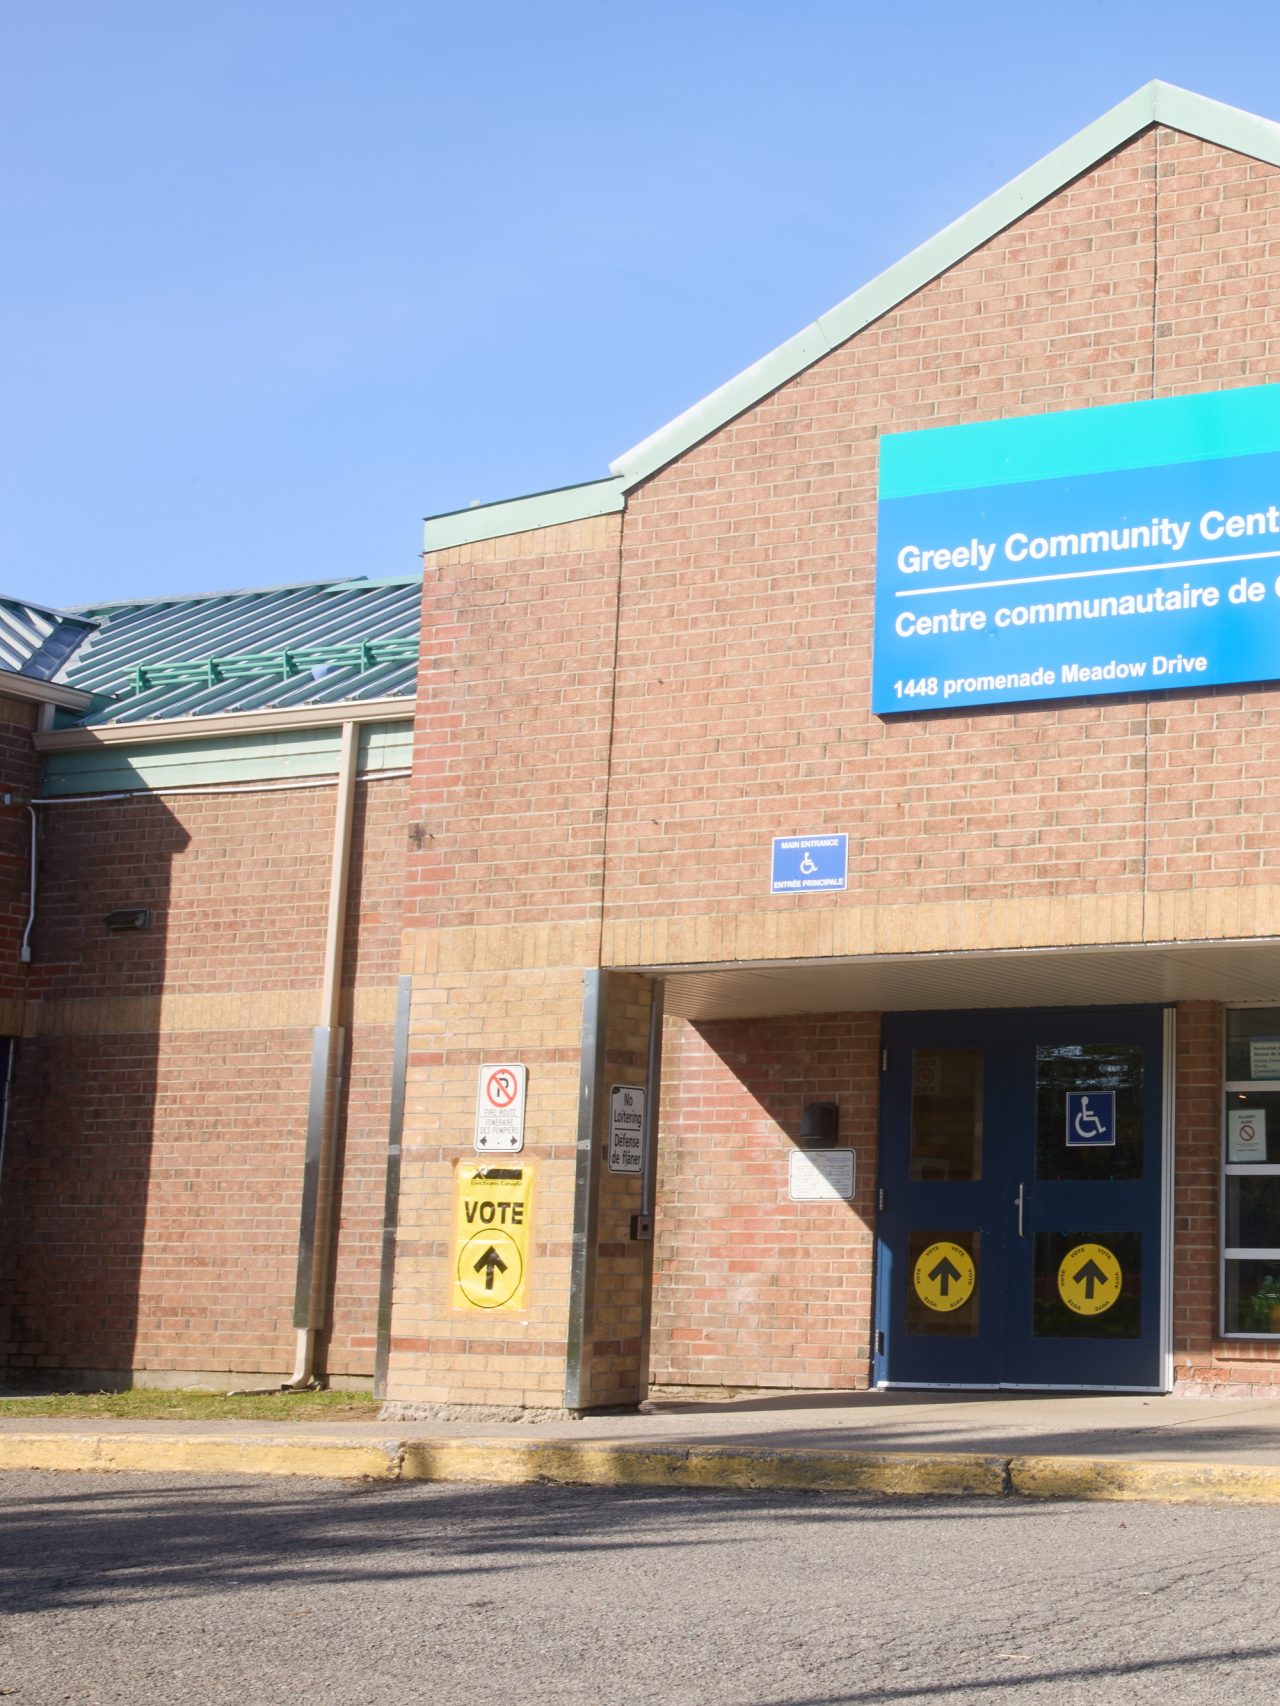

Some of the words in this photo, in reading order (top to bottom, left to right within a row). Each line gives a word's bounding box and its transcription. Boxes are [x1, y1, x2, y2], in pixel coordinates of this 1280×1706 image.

[897, 538, 996, 574] Greely
[1005, 518, 1190, 561] Community
[895, 608, 986, 638] Centre
[995, 584, 1219, 627] communautaire
[1228, 577, 1265, 604] de
[894, 677, 938, 698] 1448
[944, 667, 1055, 698] promenade
[1061, 660, 1147, 684] Meadow
[1152, 654, 1207, 675] Drive
[800, 838, 839, 848] ENTRANCE
[802, 878, 844, 887] PRINCIPALE
[624, 1092, 633, 1107] No
[614, 1109, 641, 1128] Loitering
[614, 1133, 639, 1149] Défense
[612, 1150, 619, 1165] de
[465, 1201, 524, 1224] VOTE
[926, 1246, 939, 1256] VOTE
[951, 1246, 965, 1257] VOTE
[1070, 1247, 1085, 1258] VOTE
[1097, 1247, 1112, 1259] VOTE
[924, 1296, 937, 1307] VOTE
[950, 1297, 963, 1308] VOTE
[1068, 1298, 1081, 1311] VOTE
[1095, 1300, 1110, 1311] VOTE
